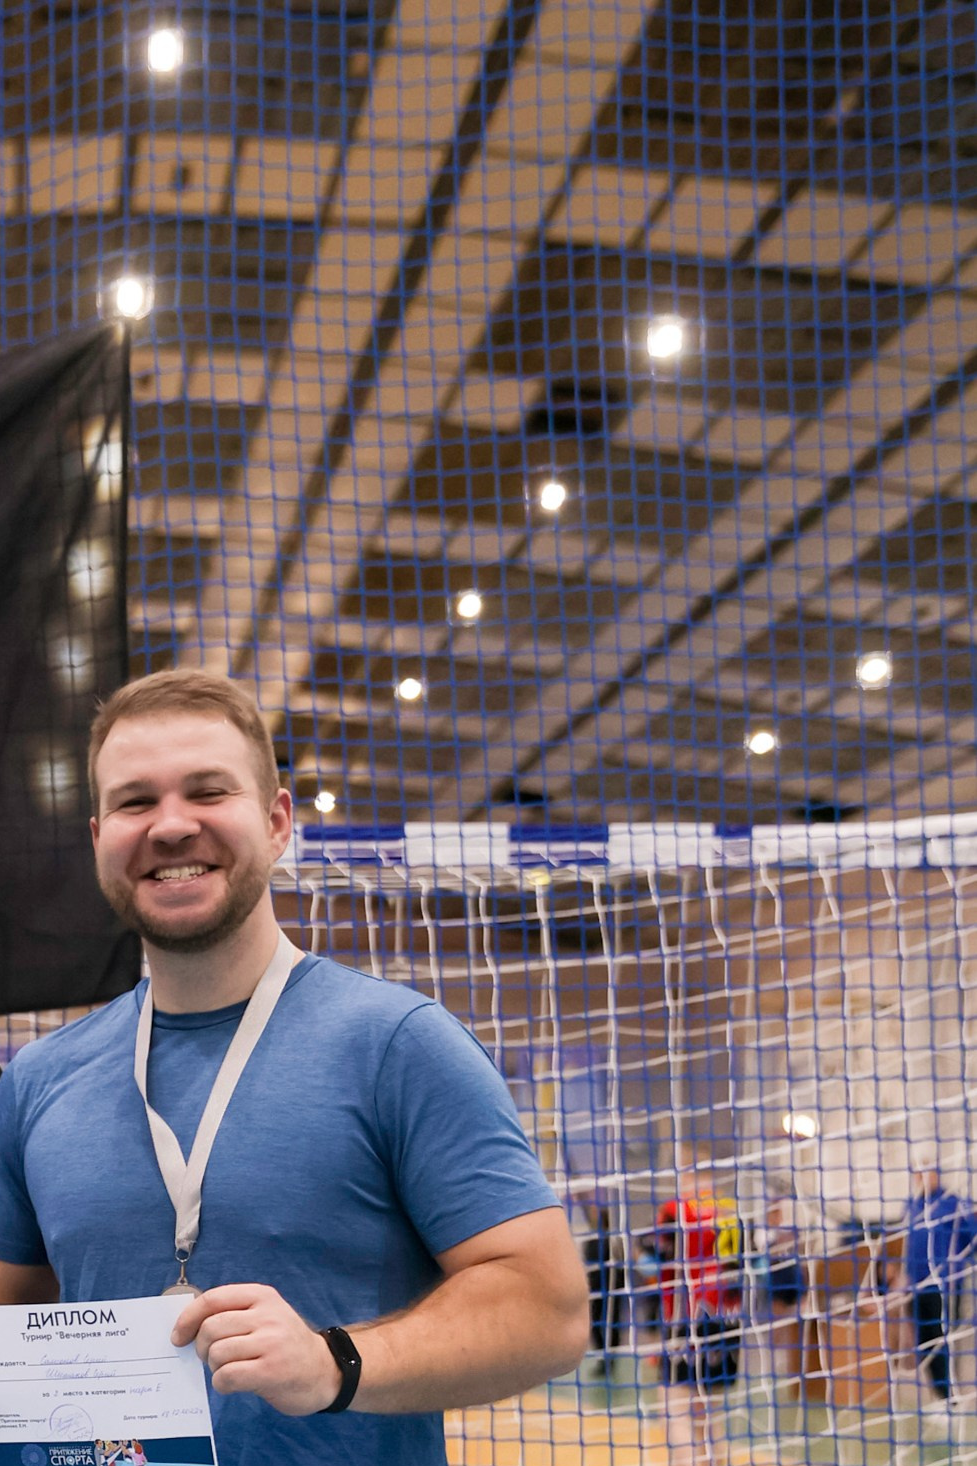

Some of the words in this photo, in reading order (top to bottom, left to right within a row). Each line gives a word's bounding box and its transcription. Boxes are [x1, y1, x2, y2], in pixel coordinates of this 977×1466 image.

[26, 1308, 117, 1330] ДИПЛОМ
[20, 1332, 53, 1343] Турнир
[56, 1329, 102, 1341] "Вечерняя
[105, 1327, 130, 1339] лига"
